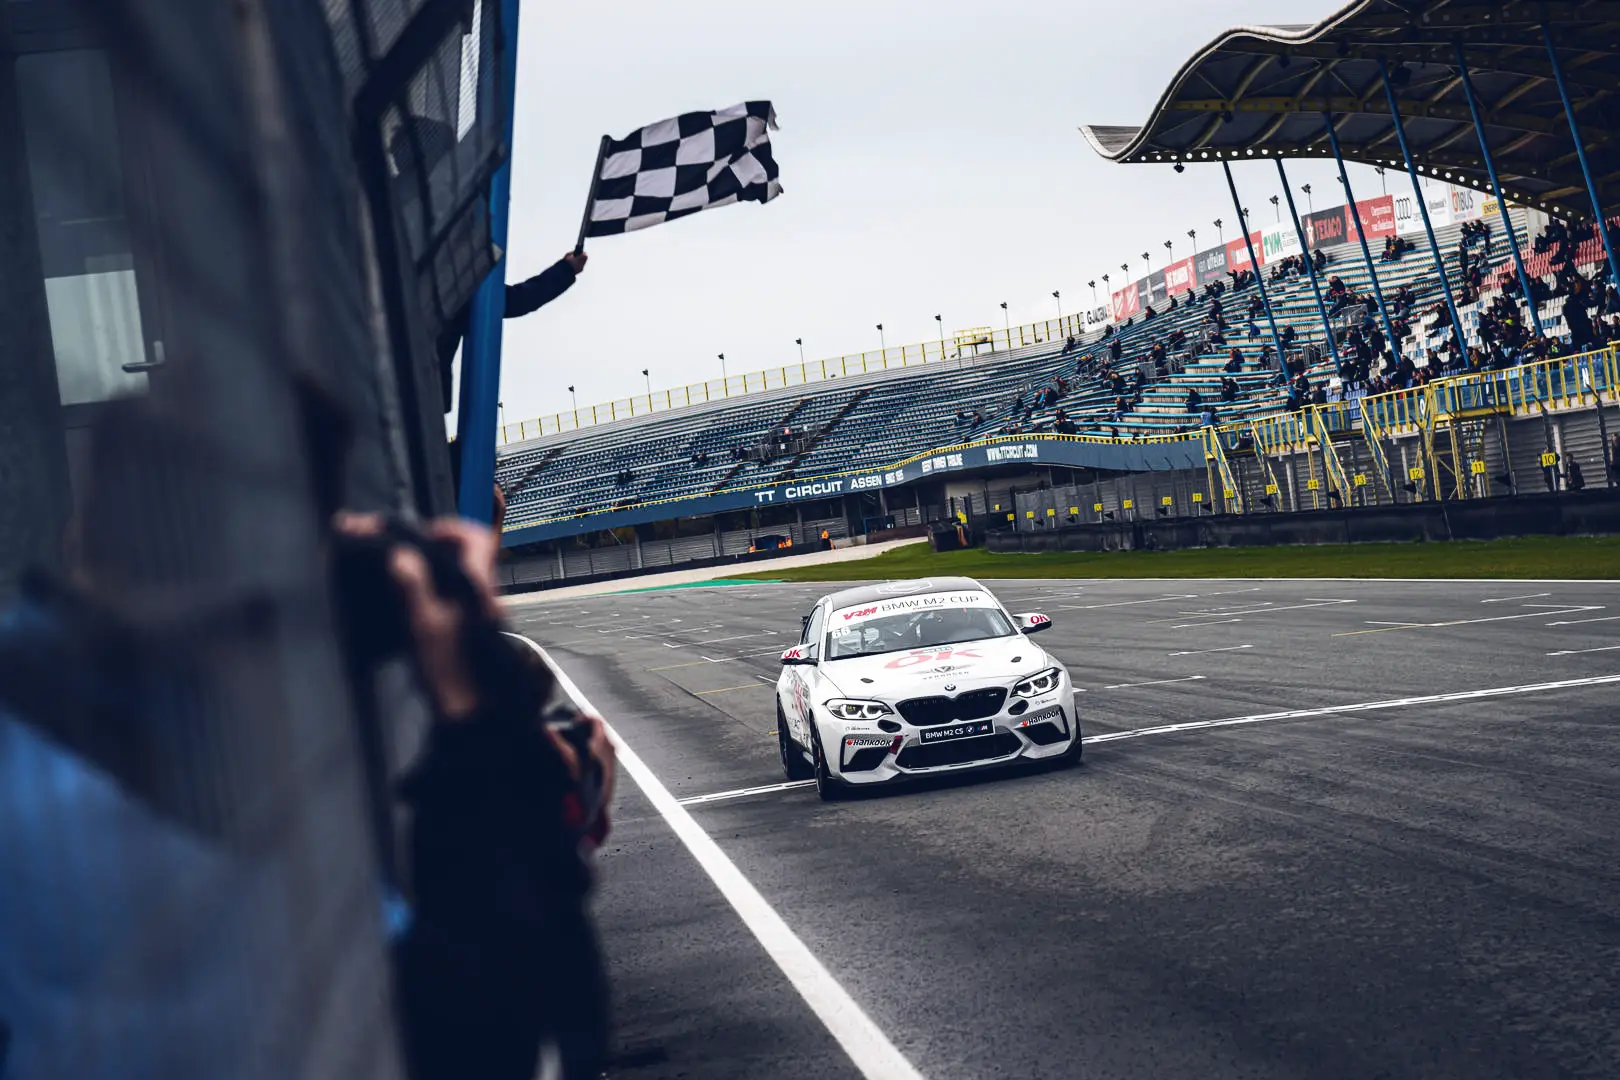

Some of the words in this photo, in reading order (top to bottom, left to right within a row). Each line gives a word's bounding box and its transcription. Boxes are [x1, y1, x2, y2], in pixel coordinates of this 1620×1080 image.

[1314, 216, 1342, 241] TEXACO
[1543, 454, 1556, 465] 10
[1473, 462, 1483, 472] 11
[1411, 468, 1421, 479] 12
[754, 490, 776, 503] TT
[785, 480, 843, 499] CIRCUIT
[850, 474, 882, 490] ASSEN
[1267, 484, 1276, 494] 15
[1309, 480, 1318, 489] 14
[881, 599, 919, 612] BMW
[923, 596, 946, 605] M2
[950, 595, 979, 604] CUP
[1030, 614, 1048, 625] OK
[784, 649, 801, 659] OK
[884, 647, 984, 669] OK
[1028, 710, 1060, 726] Hankook
[925, 731, 943, 739] BMW
[943, 729, 954, 737] M2
[853, 738, 892, 746] Hankook
